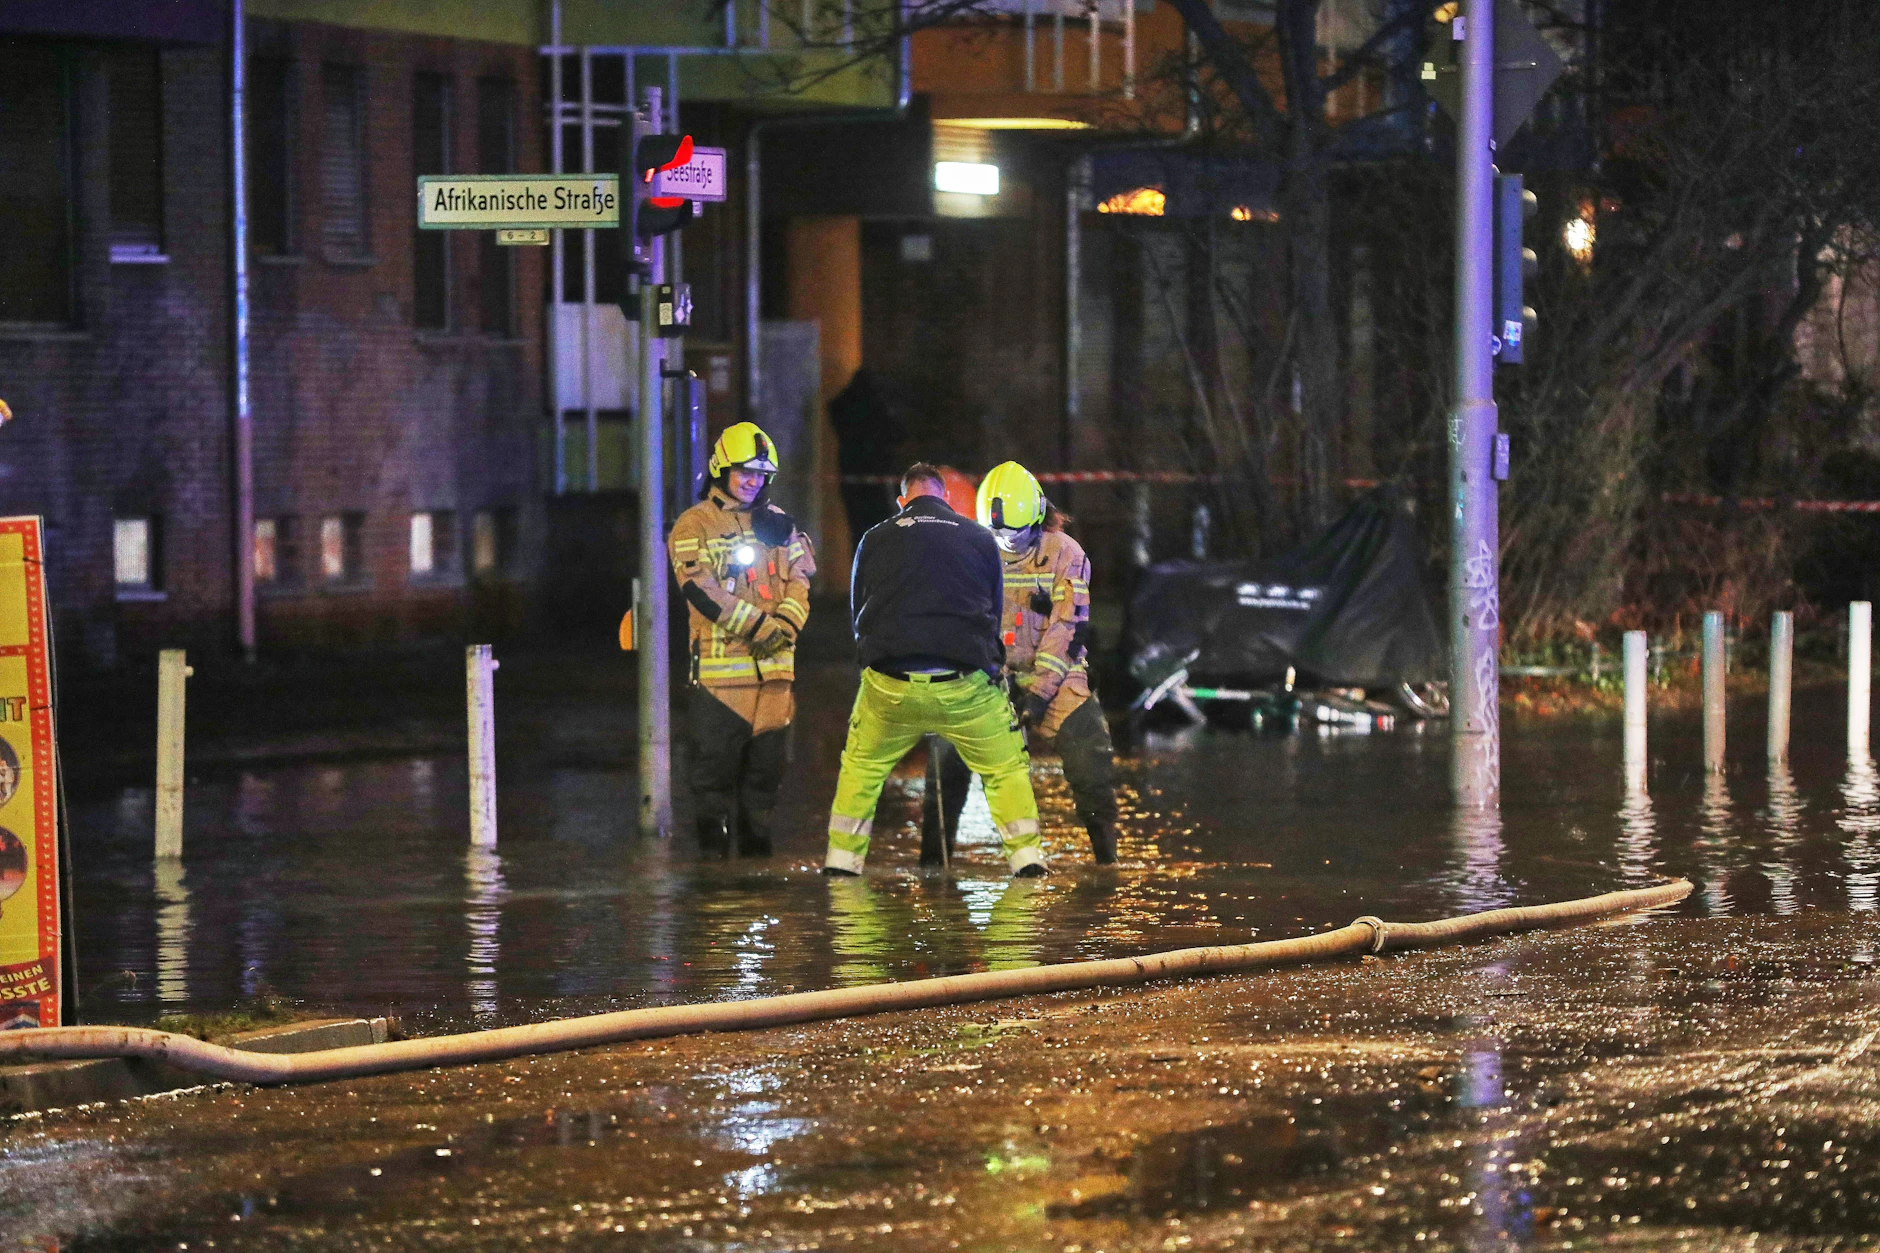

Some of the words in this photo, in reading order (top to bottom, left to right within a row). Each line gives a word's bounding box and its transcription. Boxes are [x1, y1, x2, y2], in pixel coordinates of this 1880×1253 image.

[434, 187, 548, 211] Afrikanische
[554, 187, 615, 215] Straße
[0, 977, 51, 1000] SSTE
